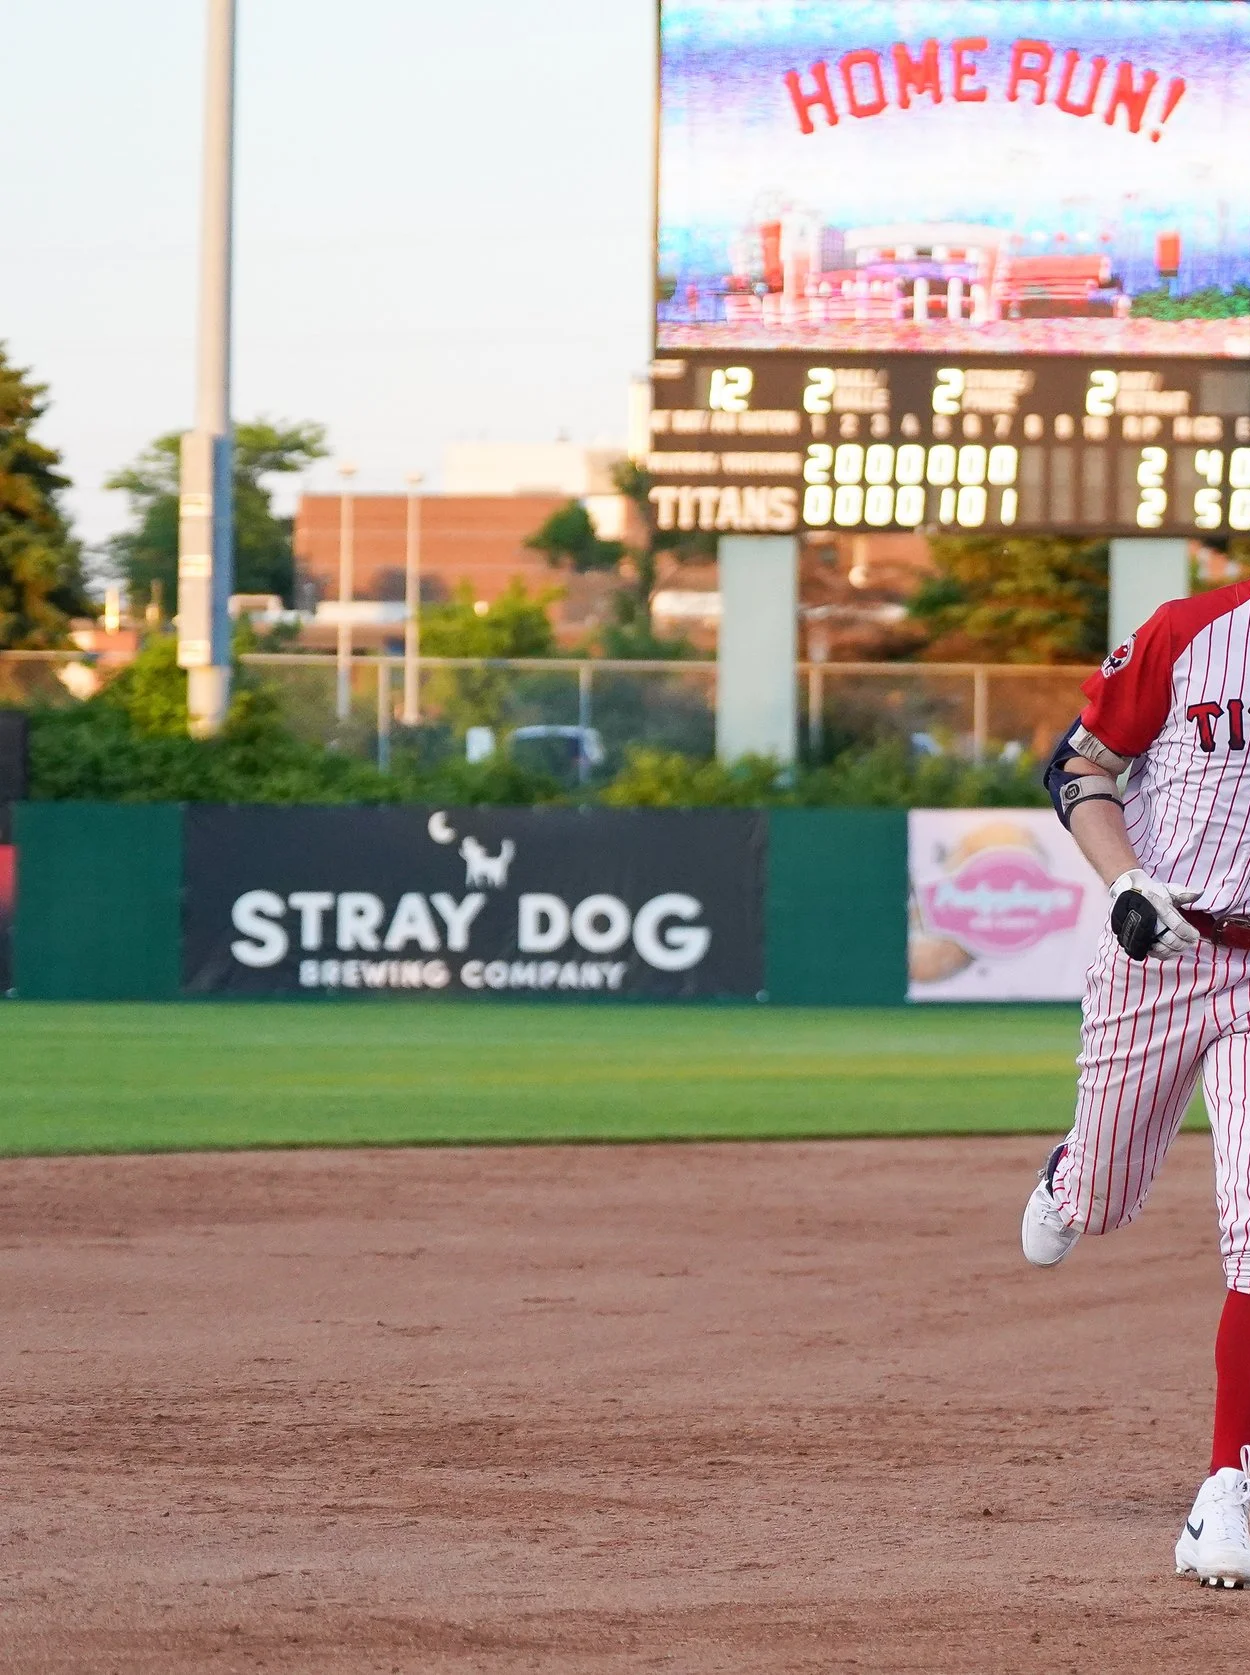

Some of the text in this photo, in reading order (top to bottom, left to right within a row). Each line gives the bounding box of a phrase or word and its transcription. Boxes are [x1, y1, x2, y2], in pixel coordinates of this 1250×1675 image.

[783, 37, 1186, 143] HOME RUN!
[709, 367, 754, 412] 12
[803, 367, 836, 414] 2
[932, 368, 964, 415] 2
[1086, 370, 1119, 417] 2
[1137, 447, 1168, 488] 2
[1195, 449, 1224, 487] 4
[648, 485, 799, 531] TITANS
[1137, 487, 1168, 528] 2
[1194, 488, 1222, 529] 5
[230, 889, 712, 971] STRAY DOG
[299, 959, 626, 990] BREWING COMPANY
